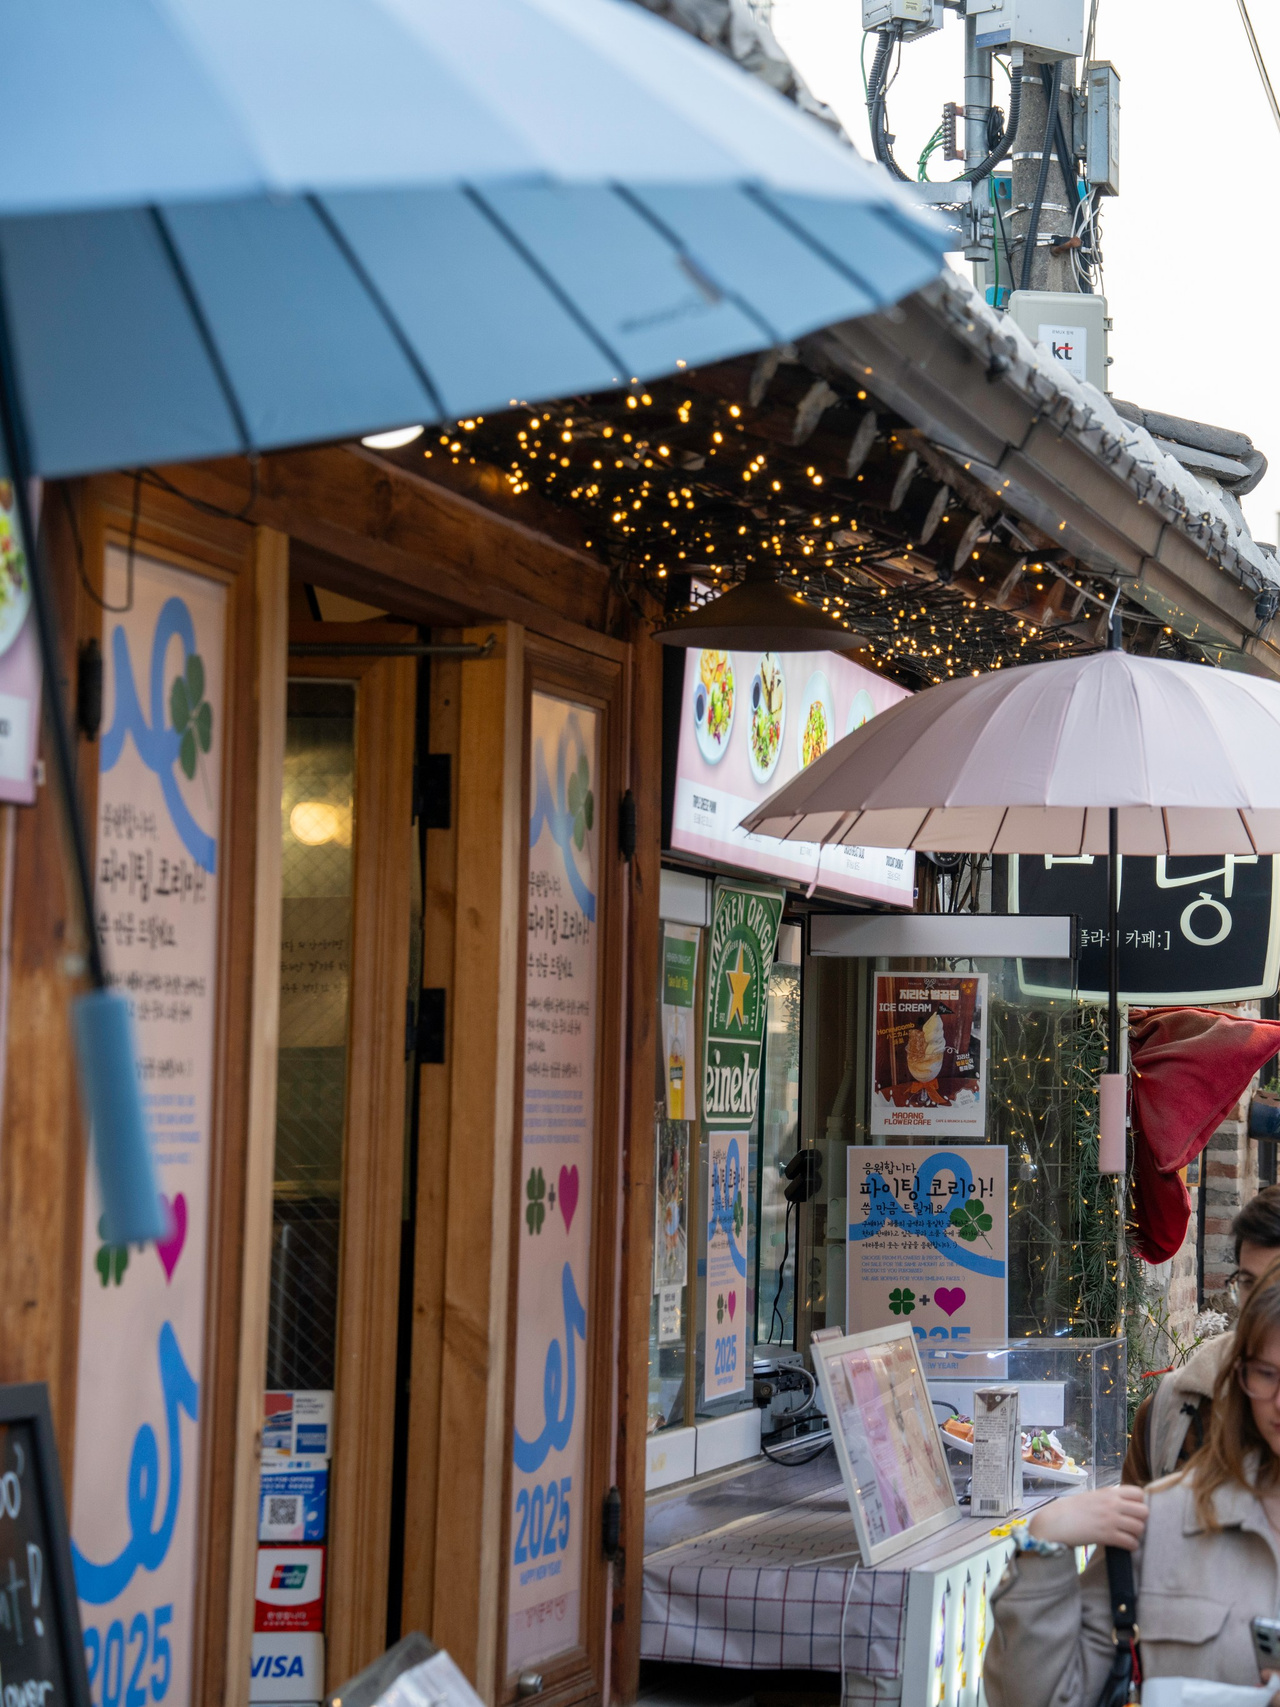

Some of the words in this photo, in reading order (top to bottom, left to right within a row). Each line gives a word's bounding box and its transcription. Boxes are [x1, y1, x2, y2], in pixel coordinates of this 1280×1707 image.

[1052, 342, 1073, 360] kt
[900, 989, 929, 1000] 지리산
[879, 1003, 896, 1012] ICE
[898, 1003, 932, 1012] CREAM
[862, 1161, 919, 1175] 응원합니다.
[860, 1175, 920, 1201] 파이팅
[926, 1177, 994, 1199] 코리아!
[861, 1201, 872, 1215] 쓴
[876, 1201, 898, 1216] 만큼
[902, 1201, 948, 1216] 드릴게요.
[714, 1334, 737, 1376] 2025
[937, 1362, 959, 1370] YEAR!
[514, 1476, 572, 1565] 2025
[83, 1603, 173, 1707] 2025
[250, 1655, 304, 1678] VISA
